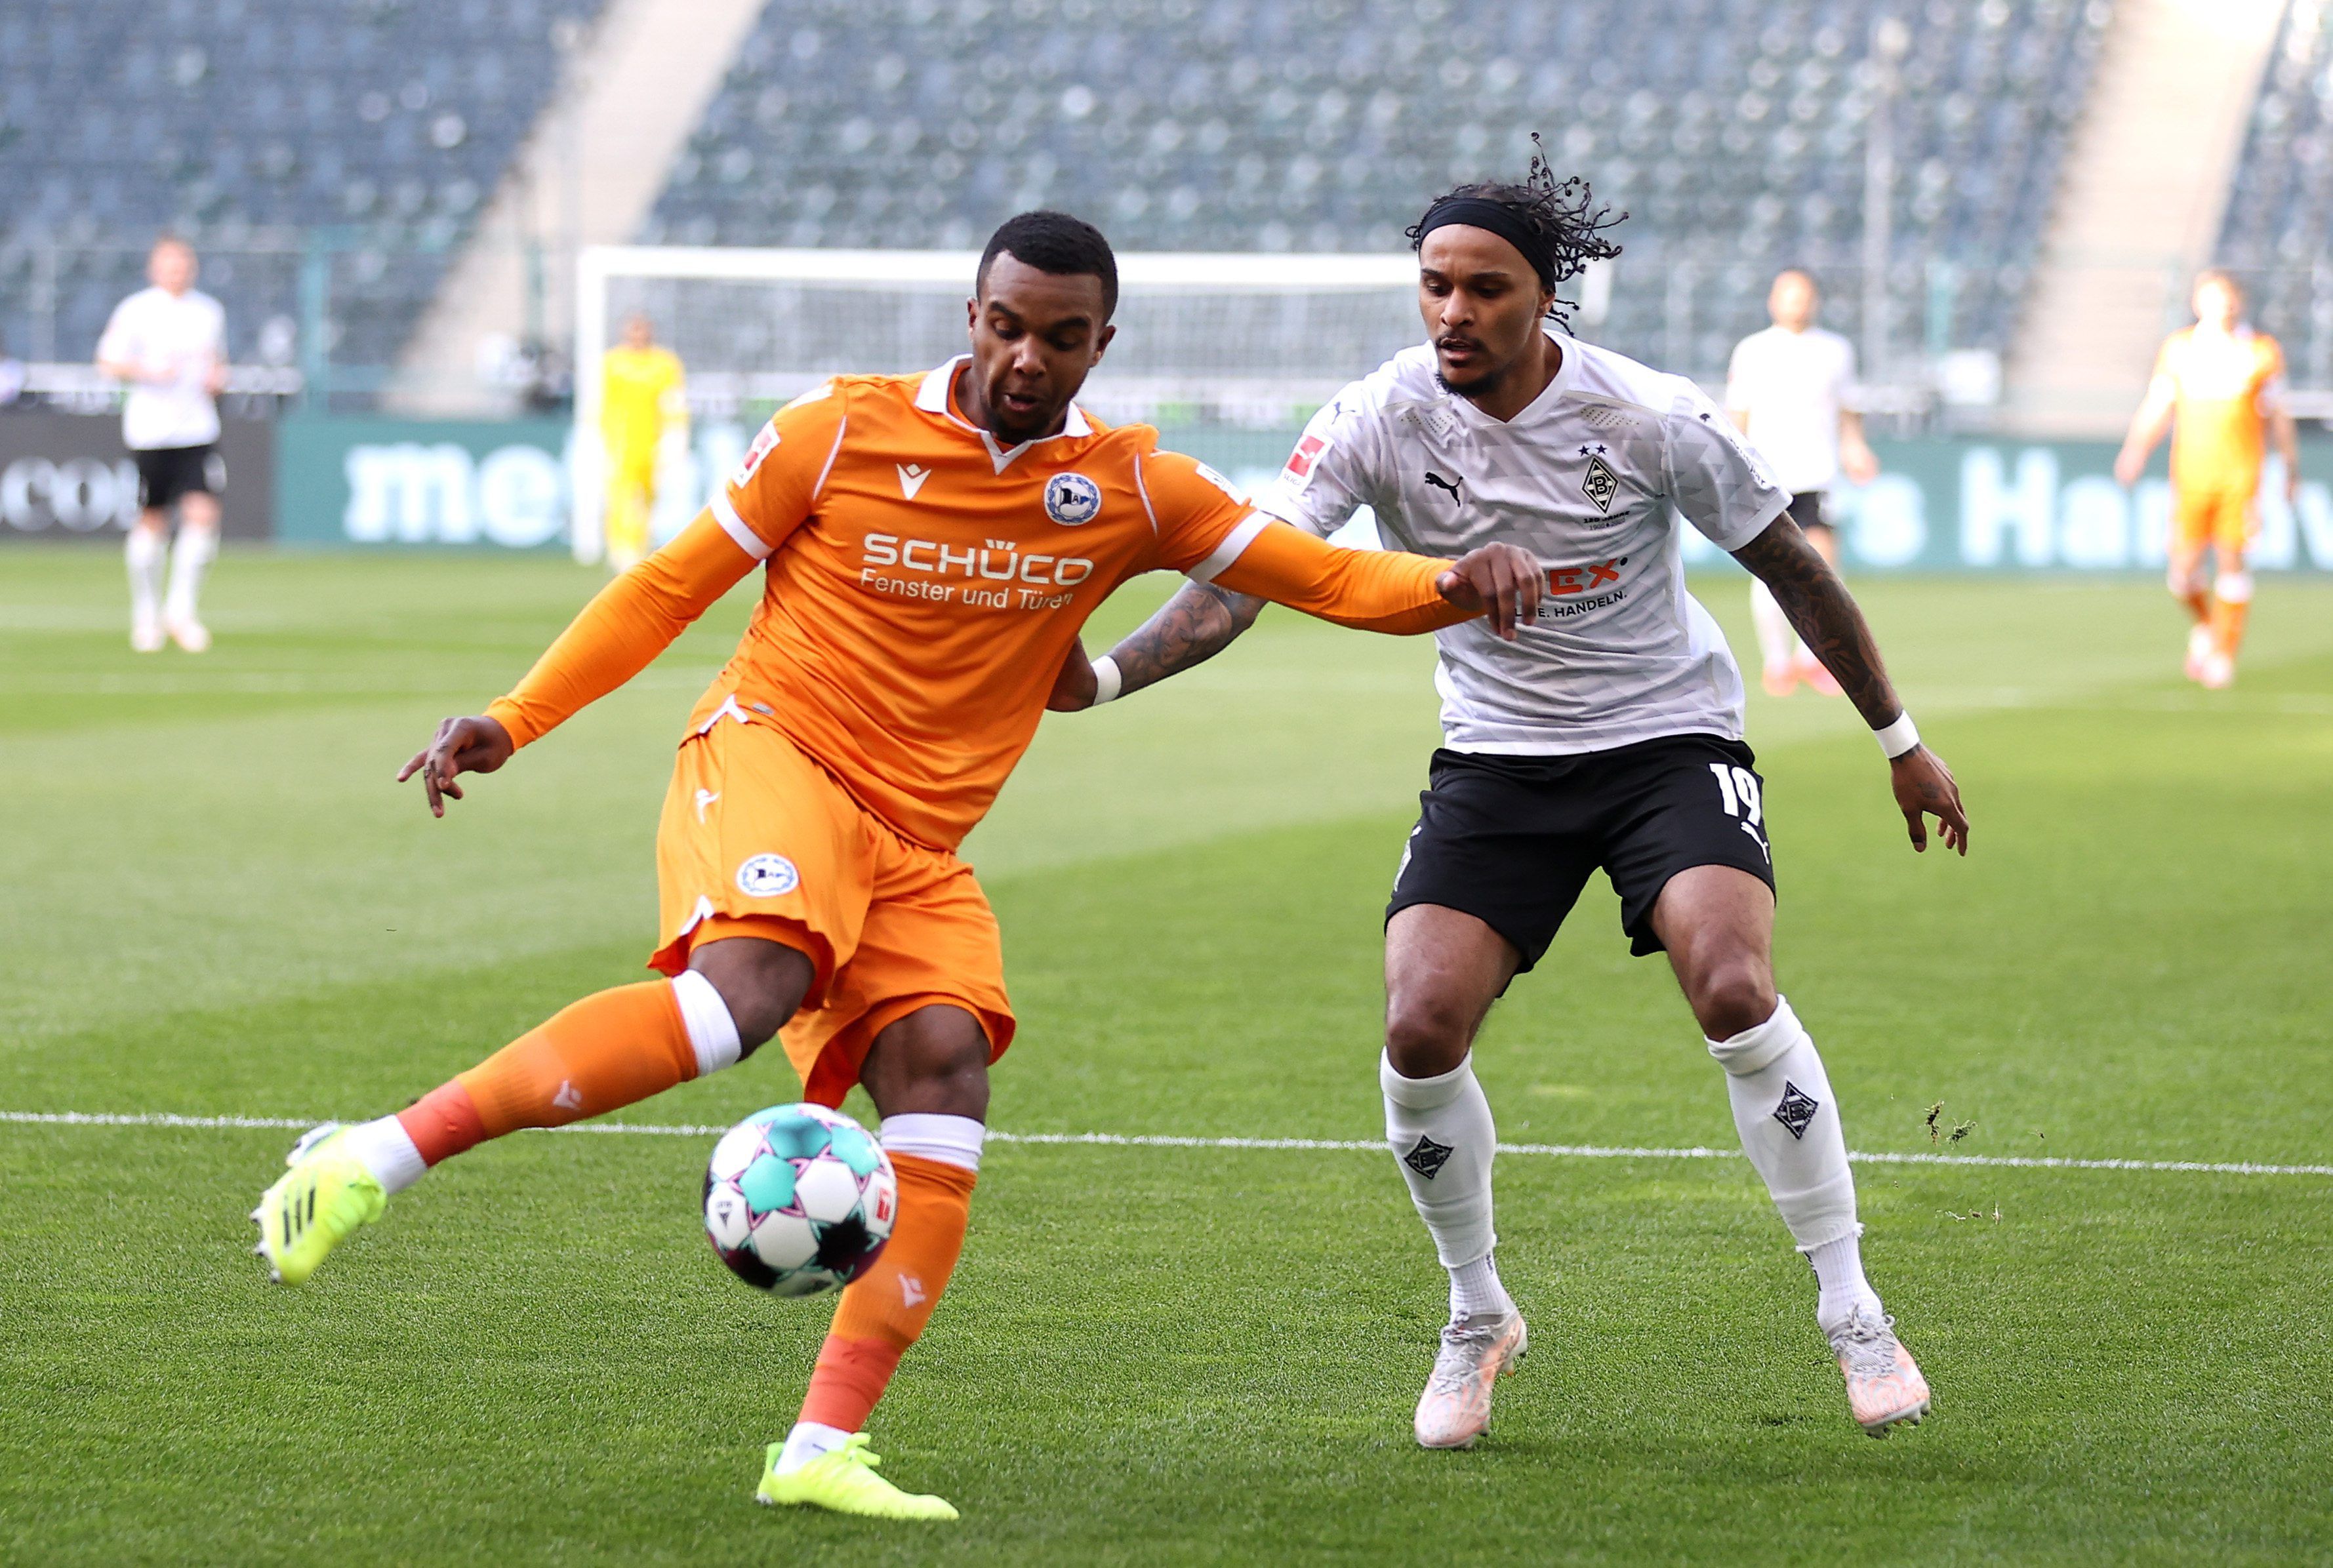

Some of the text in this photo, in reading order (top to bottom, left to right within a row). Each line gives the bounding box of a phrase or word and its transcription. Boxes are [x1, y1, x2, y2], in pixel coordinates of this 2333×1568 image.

[863, 533, 1094, 586] SCHÜCO
[861, 568, 1073, 609] Fenster und Türen
[1555, 590, 1627, 617] HANDELN.
[1709, 763, 1761, 827] 19
